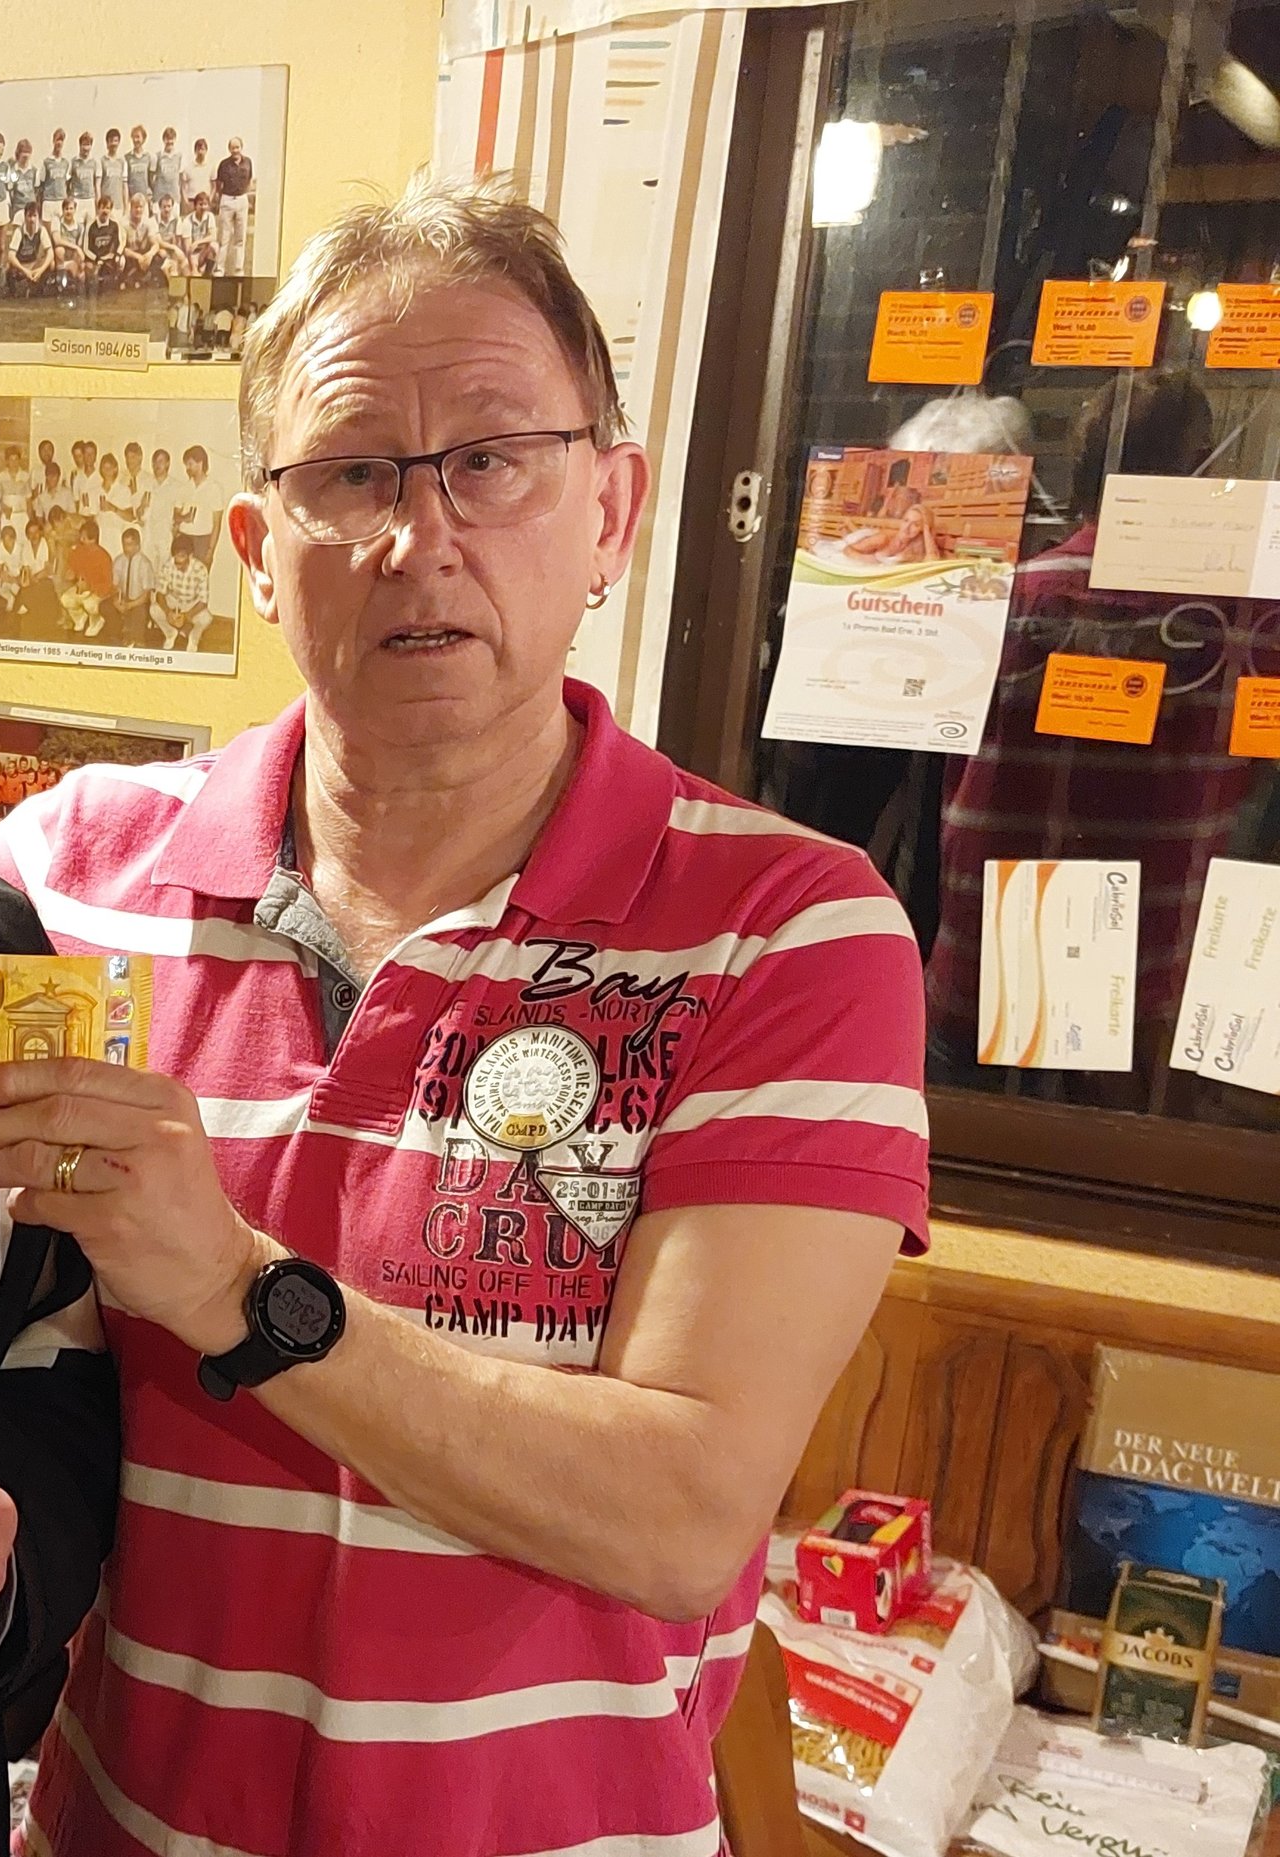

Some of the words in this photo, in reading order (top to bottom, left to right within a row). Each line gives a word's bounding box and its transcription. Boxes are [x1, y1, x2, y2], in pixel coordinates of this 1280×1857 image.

[51, 339, 92, 354] Saison
[96, 341, 140, 358] 1984/85
[847, 591, 944, 616] Gutschein
[70, 649, 102, 661] Aufstieg
[115, 652, 126, 661] die
[129, 653, 164, 665] Kreisliga
[167, 656, 173, 664] B
[1202, 895, 1228, 959] Freikarte
[1244, 906, 1277, 971] Freikarte
[520, 939, 697, 1054] Bay
[1108, 974, 1125, 1037] Freikarte
[476, 1037, 518, 1089] ISLANDS
[501, 1052, 519, 1069] THE
[522, 1048, 571, 1082] WINTERLESS
[531, 1031, 588, 1069] MARITIME
[473, 1094, 486, 1109] OF
[490, 1082, 509, 1117] SAILING
[546, 1084, 571, 1116] NORTH
[550, 1072, 590, 1134] RESERVE
[436, 1137, 621, 1204] DAY
[580, 1201, 603, 1210] CAMP
[381, 1260, 467, 1291] SAILING
[478, 1269, 533, 1296] OFF
[547, 1274, 592, 1299] THE
[425, 1291, 522, 1338] CAMP
[1108, 1451, 1194, 1484] ADAC
[1114, 1430, 1163, 1455] DER
[1170, 1440, 1240, 1469] NEUE
[1120, 1642, 1195, 1670] JACOBS
